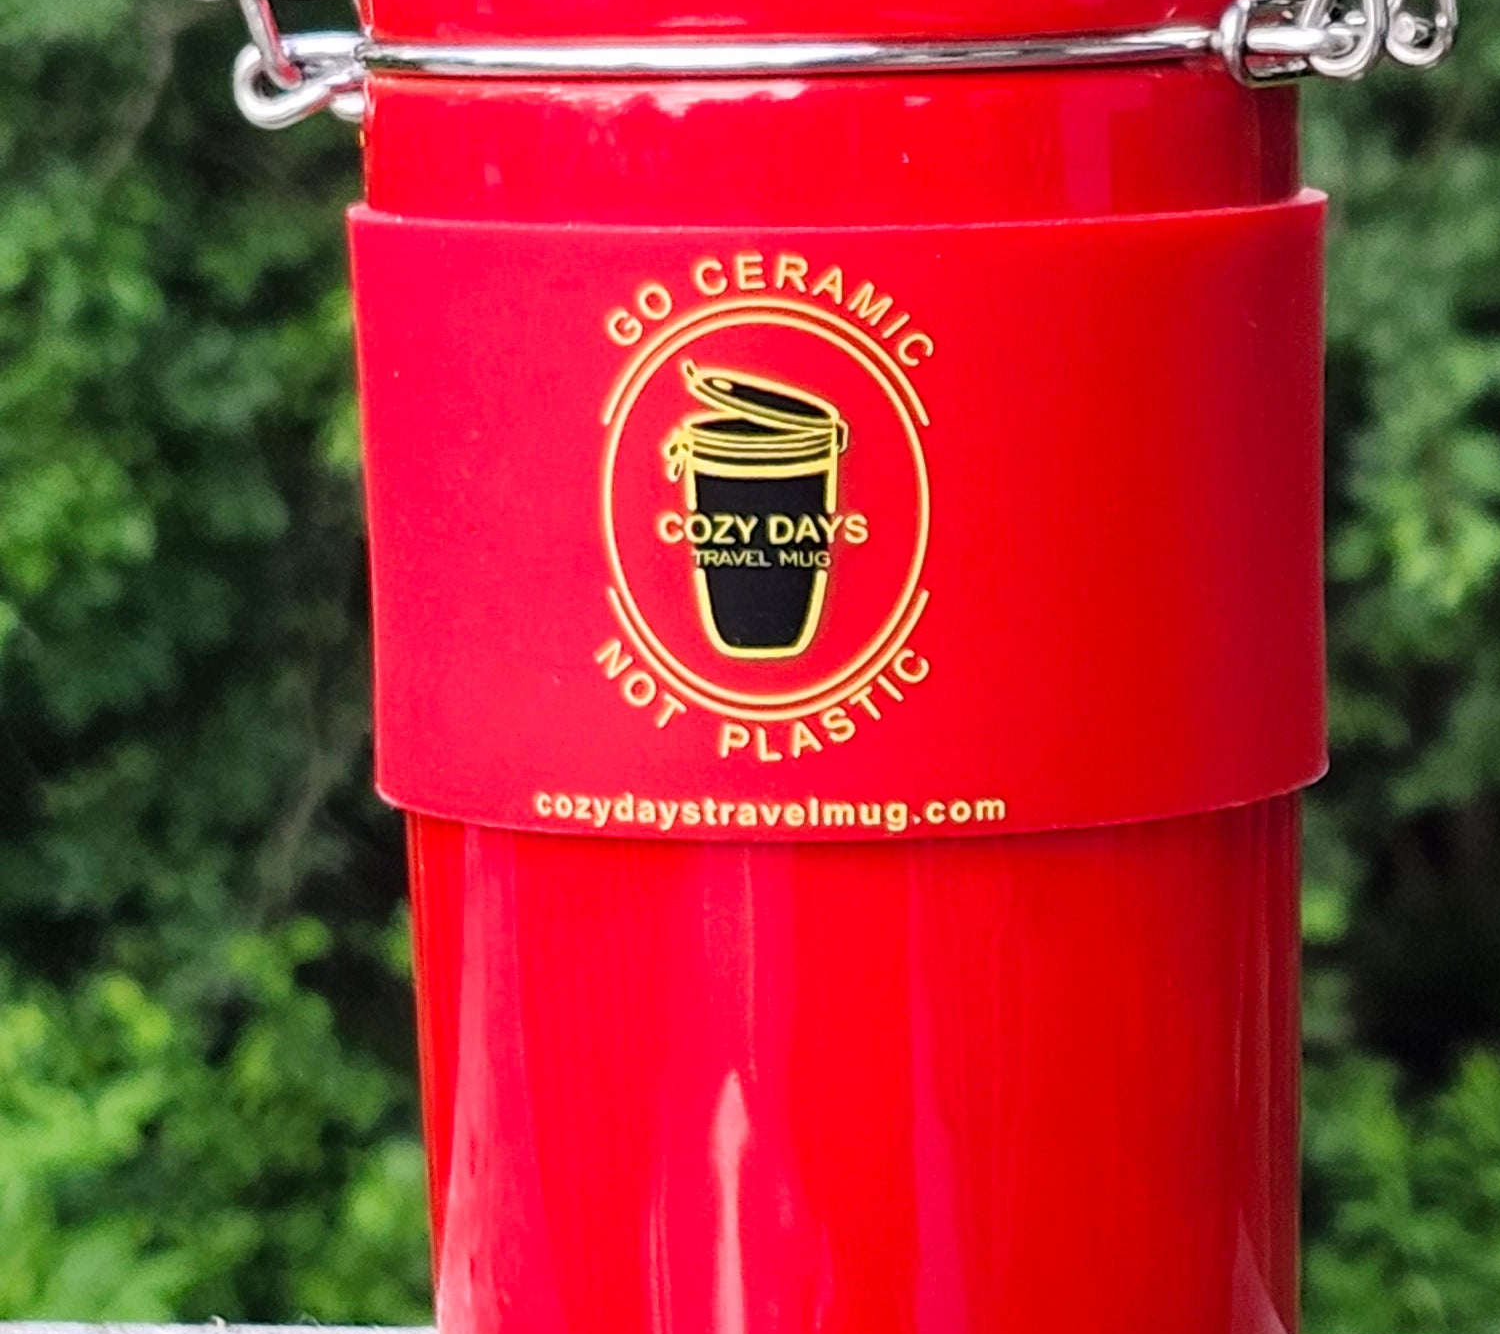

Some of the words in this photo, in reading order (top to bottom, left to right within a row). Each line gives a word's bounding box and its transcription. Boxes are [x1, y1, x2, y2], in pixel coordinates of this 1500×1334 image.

[606, 284, 674, 348] GO
[694, 254, 935, 368] CERAMIC
[658, 512, 758, 545] COZY
[768, 514, 869, 545] DAYS
[693, 549, 772, 568] TRAVEL
[779, 550, 831, 568] MUG
[596, 639, 688, 730] NOT
[718, 648, 931, 762] PLASTIC
[534, 790, 1007, 832] cozydaystravelmug.com
